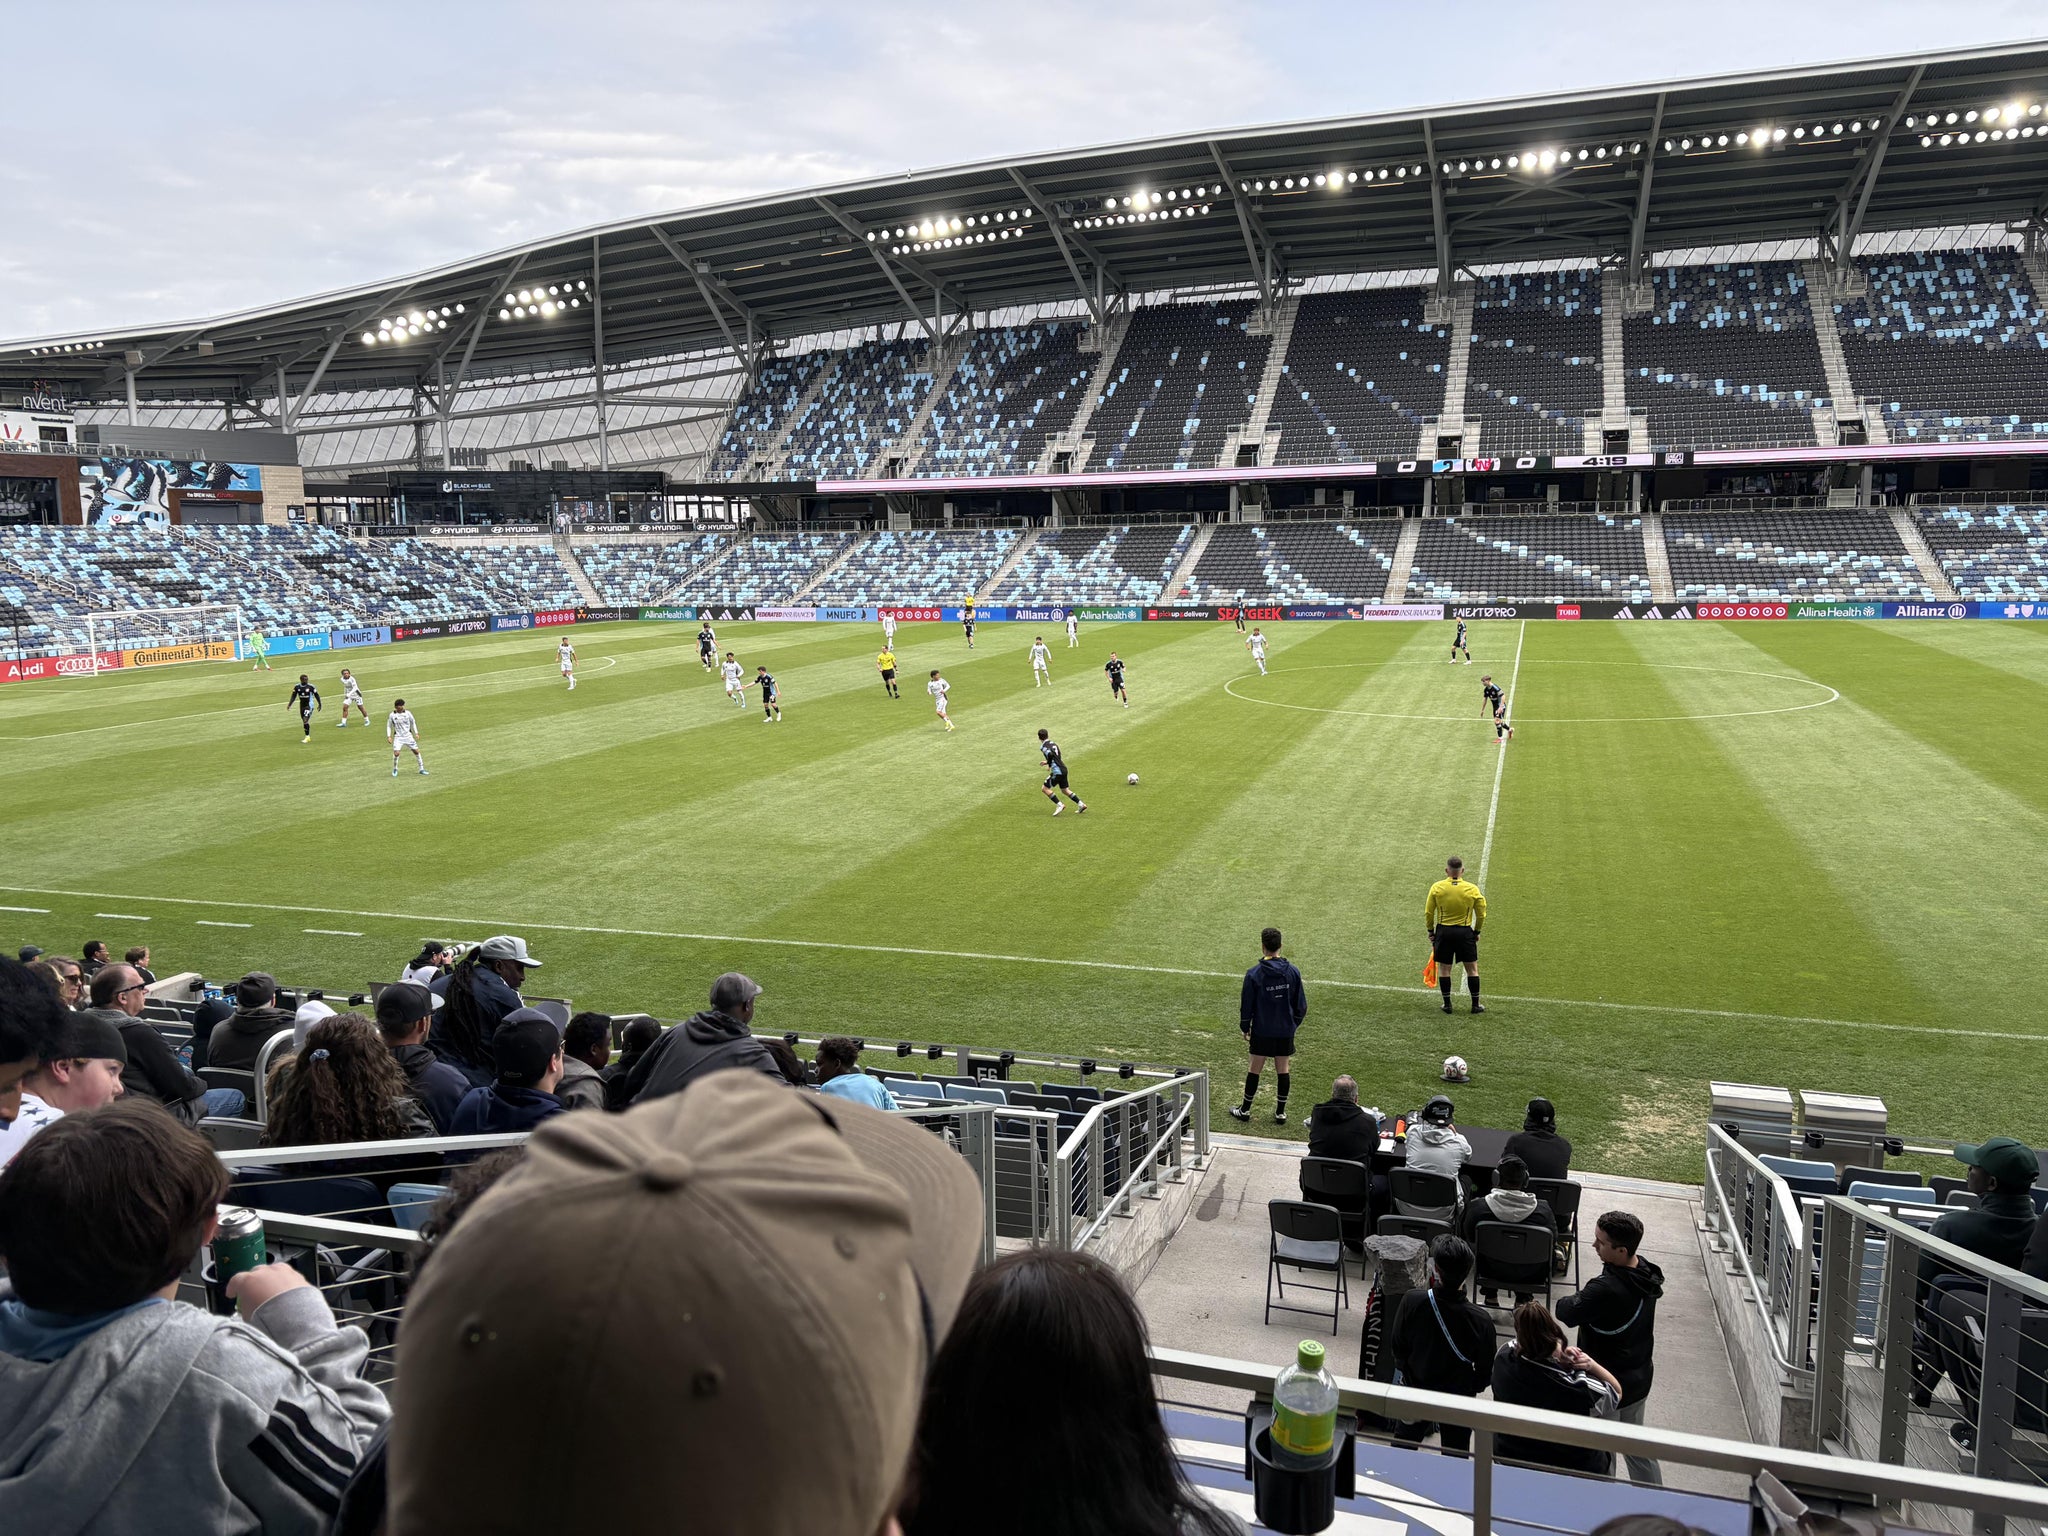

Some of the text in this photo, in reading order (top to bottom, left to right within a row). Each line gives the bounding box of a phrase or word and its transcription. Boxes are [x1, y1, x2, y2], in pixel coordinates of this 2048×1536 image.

[22, 392, 67, 412] nVent
[1582, 456, 1628, 466] 4:19
[385, 528, 410, 536] HYUNDAI
[444, 527, 480, 535] HYUNDAI
[505, 526, 539, 534] HYUNDAI
[597, 525, 630, 533] HYUNDAI
[652, 524, 684, 532] HYUNDAI
[707, 523, 736, 531] HYUNDAI
[826, 610, 857, 620] MNUFC
[1015, 610, 1049, 620] Allianz
[1365, 609, 1399, 617] FEDERATED
[1797, 606, 1862, 618] Allina Health
[1896, 605, 1945, 617] Allianz
[2037, 606, 2048, 616] M
[497, 618, 520, 629] Allianz
[305, 637, 322, 647] AT&T
[343, 633, 372, 644] MNUFC
[134, 646, 195, 666] Continental
[8, 662, 45, 678] Audi
